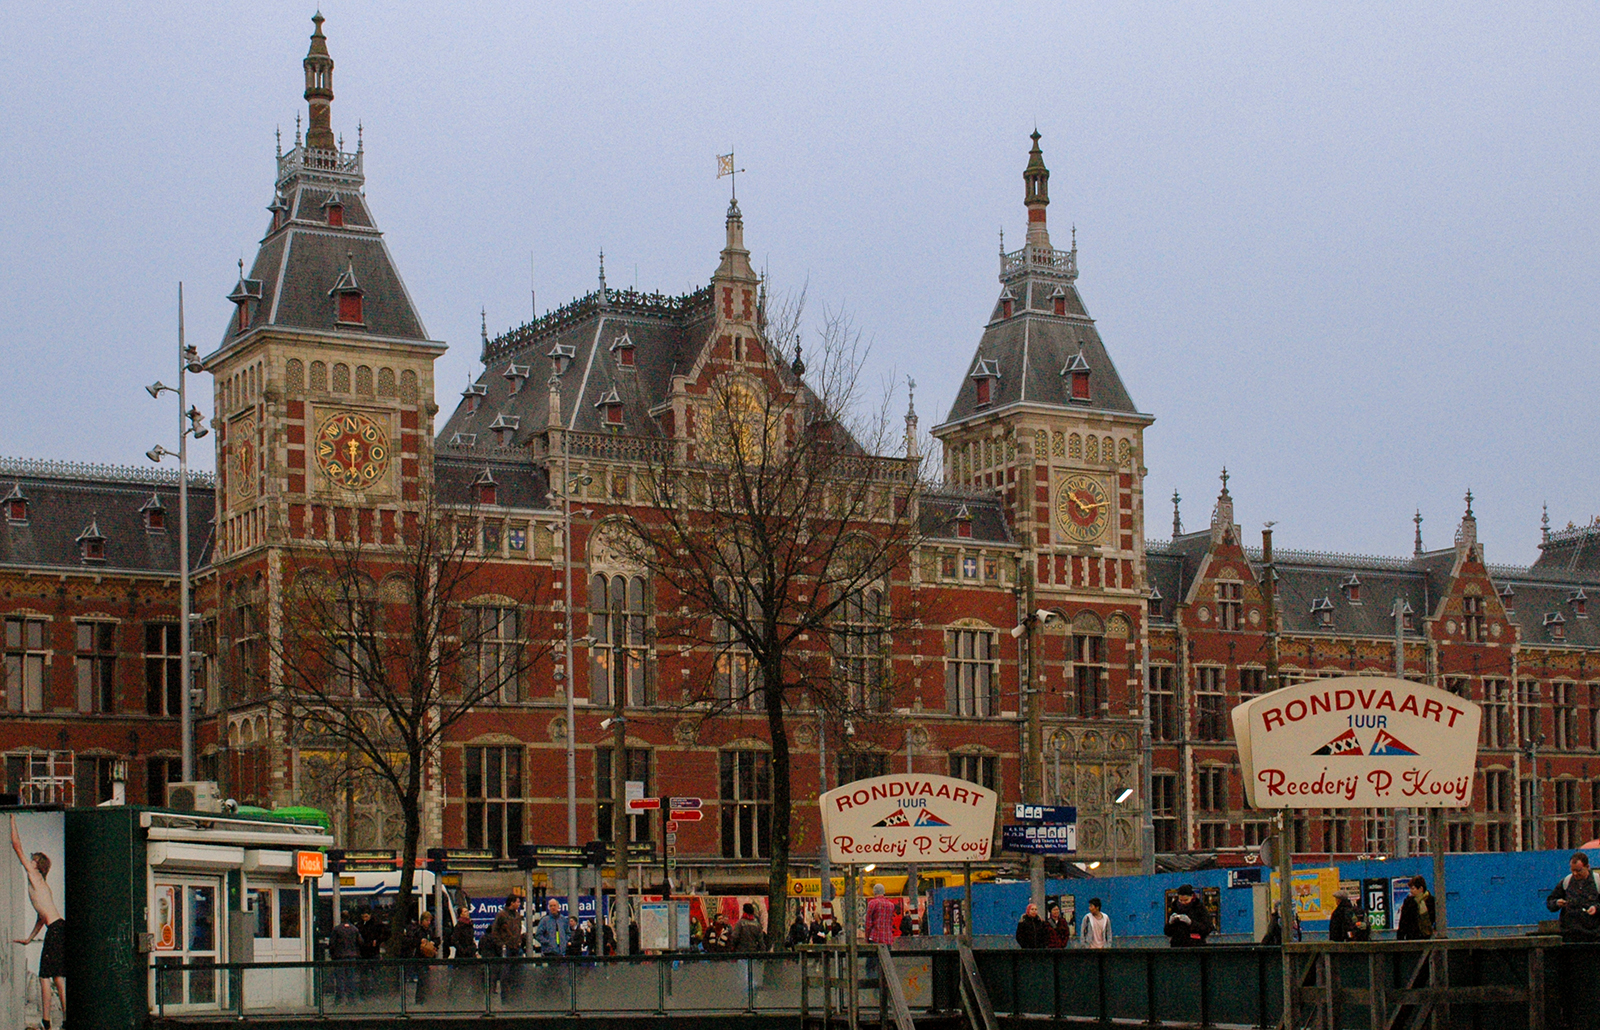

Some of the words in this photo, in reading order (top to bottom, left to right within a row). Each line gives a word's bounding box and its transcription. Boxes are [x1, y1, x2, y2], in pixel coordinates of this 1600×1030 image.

[1261, 689, 1465, 732] RONDVAART
[1374, 734, 1393, 754] K
[1257, 769, 1359, 801] Reederij
[1367, 769, 1393, 797] P.
[1401, 768, 1469, 801] Kooij
[835, 781, 984, 813] RONDVAART
[918, 811, 932, 826] K
[833, 835, 908, 857] Reederij
[913, 836, 932, 855] P.
[938, 834, 989, 856] Kooij
[300, 855, 321, 872] Kiosk
[1368, 891, 1385, 912] Ja
